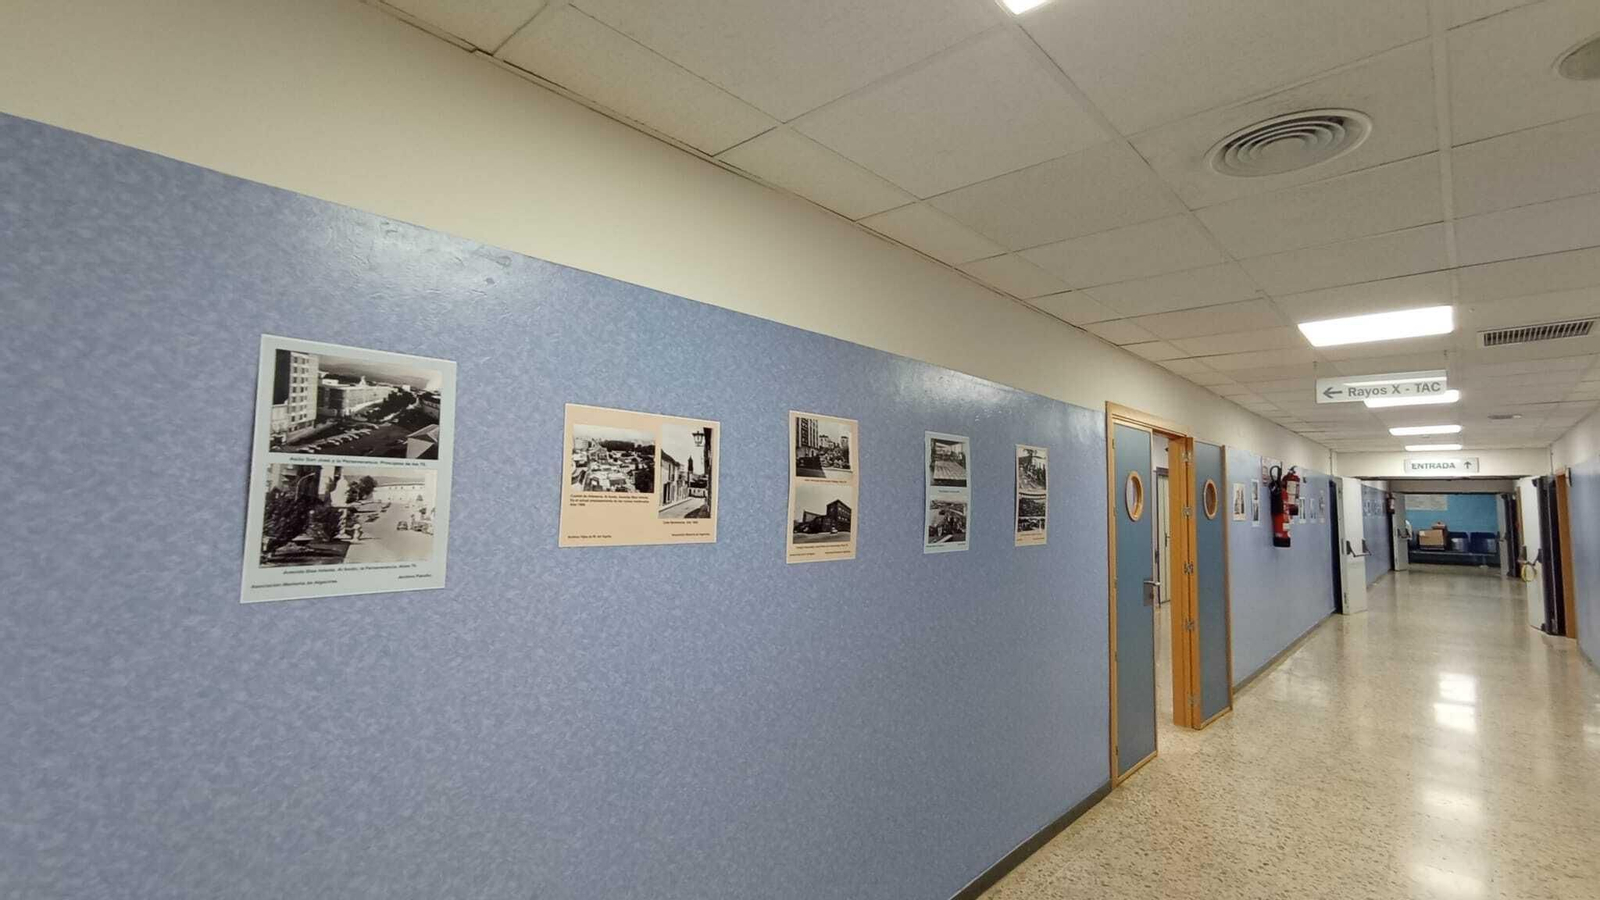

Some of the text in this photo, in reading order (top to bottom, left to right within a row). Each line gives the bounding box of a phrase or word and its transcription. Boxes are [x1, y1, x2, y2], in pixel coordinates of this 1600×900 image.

[1348, 386, 1387, 398] Rayos
[1391, 384, 1401, 395] X
[1414, 381, 1441, 393] TAC
[1411, 462, 1456, 470] ENTRADA
